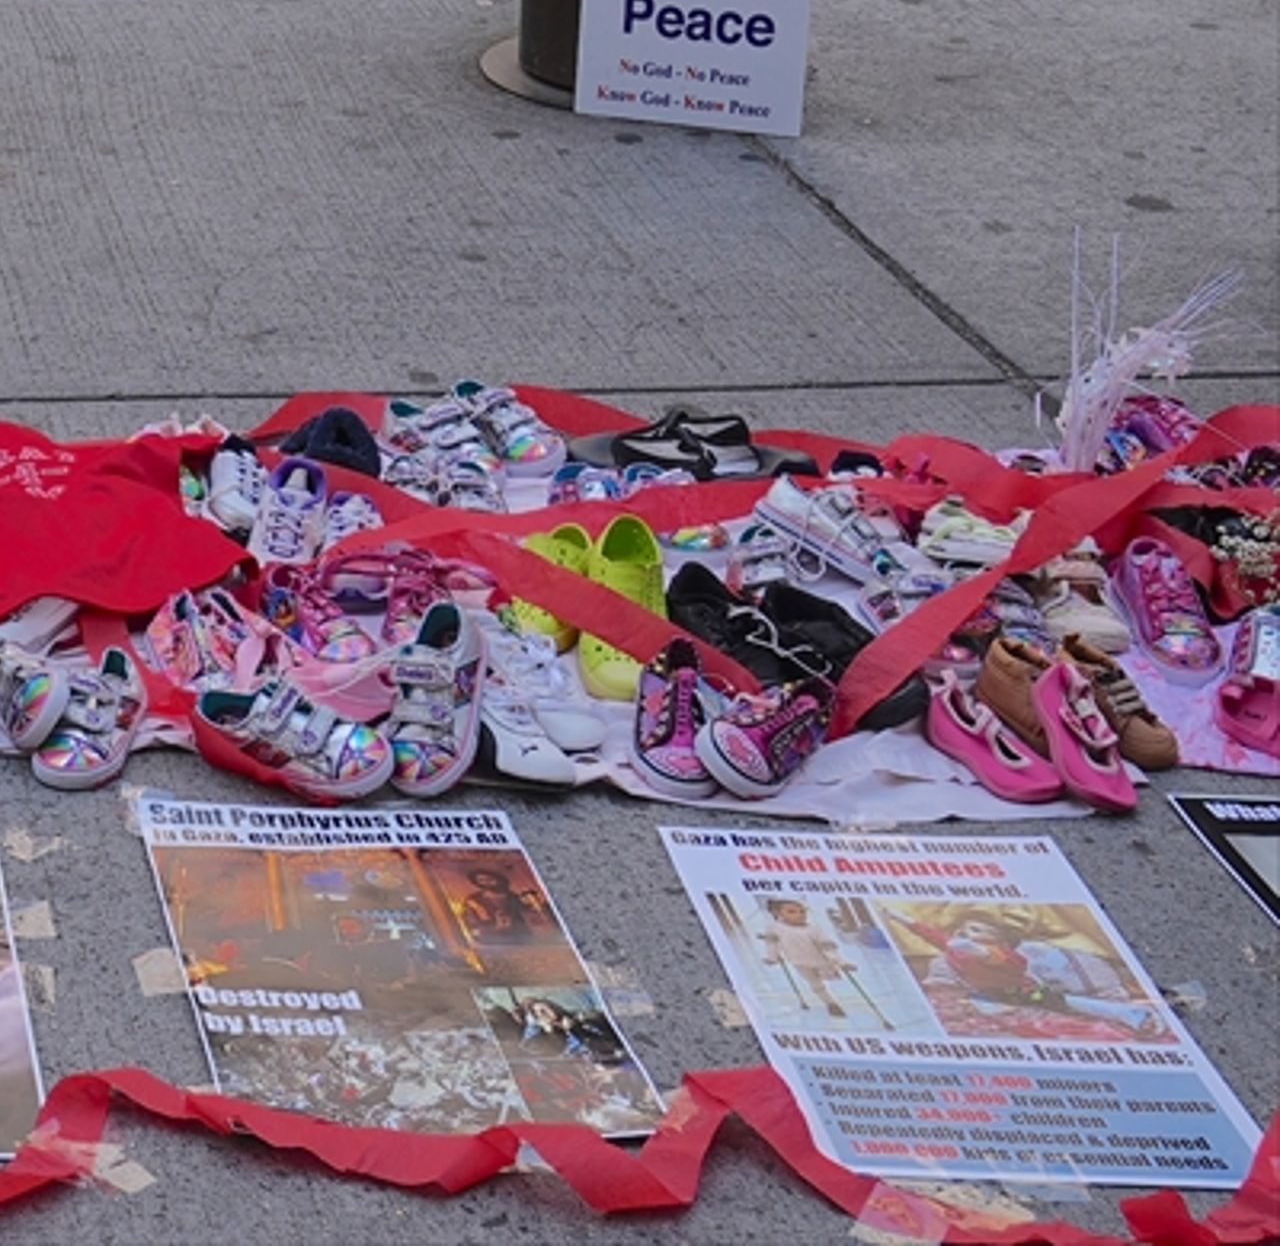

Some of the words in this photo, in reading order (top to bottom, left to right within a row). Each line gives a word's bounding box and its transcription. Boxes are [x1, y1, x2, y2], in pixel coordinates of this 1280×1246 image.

[619, 58, 640, 74] No
[642, 62, 673, 80] God
[686, 65, 706, 83] No
[709, 68, 750, 87] Peace
[596, 85, 637, 103] Know
[640, 89, 670, 108] God
[683, 95, 725, 113] Know
[729, 99, 771, 119] Peace
[149, 803, 224, 827] Saint
[233, 807, 391, 833] Porphyrius
[395, 812, 504, 831] Church
[248, 830, 392, 846] established
[670, 830, 728, 847] Gaza
[729, 833, 777, 849] has
[778, 835, 821, 851] the
[824, 837, 918, 856] highest
[922, 840, 1018, 855] number
[1023, 841, 1050, 854] of
[739, 852, 828, 875] Child
[834, 856, 1007, 879] Amputees
[742, 878, 784, 894] per
[788, 879, 871, 896] capita
[873, 881, 901, 895] in
[902, 881, 941, 896] the
[947, 883, 1030, 898] world.
[195, 985, 363, 1010] Destroyed
[203, 1011, 245, 1034] by
[249, 1013, 348, 1036] Israel
[771, 1031, 842, 1052] With
[844, 1036, 886, 1055] US
[1033, 1043, 1124, 1065] Israel
[1125, 1047, 1194, 1067] has:
